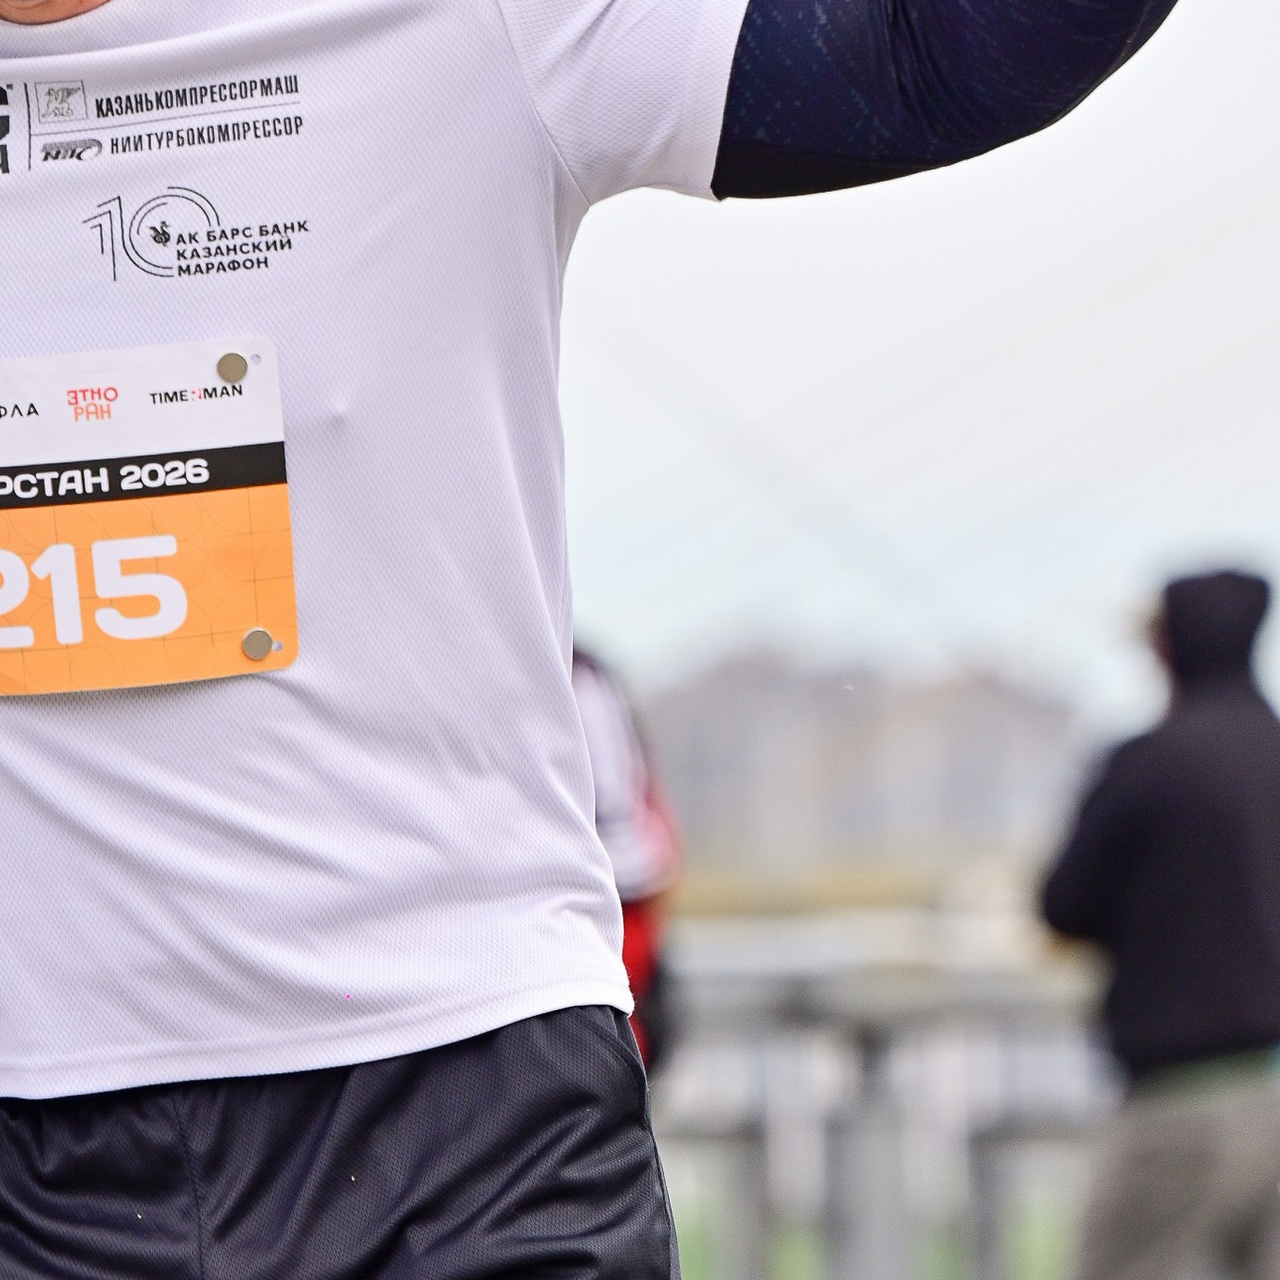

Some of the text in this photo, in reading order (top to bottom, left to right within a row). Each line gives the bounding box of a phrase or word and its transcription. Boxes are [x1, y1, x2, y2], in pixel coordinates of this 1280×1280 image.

[95, 75, 299, 118] КАЗАНЬКОМПРЕССОРМАШ
[176, 220, 309, 245] АК БАРС БАНК
[176, 233, 293, 261] КАЗАНСКИЙ
[177, 256, 269, 277] МАРАФОН
[67, 387, 118, 405] ЭТНО
[74, 402, 112, 422] РАН
[120, 458, 210, 489] 2026
